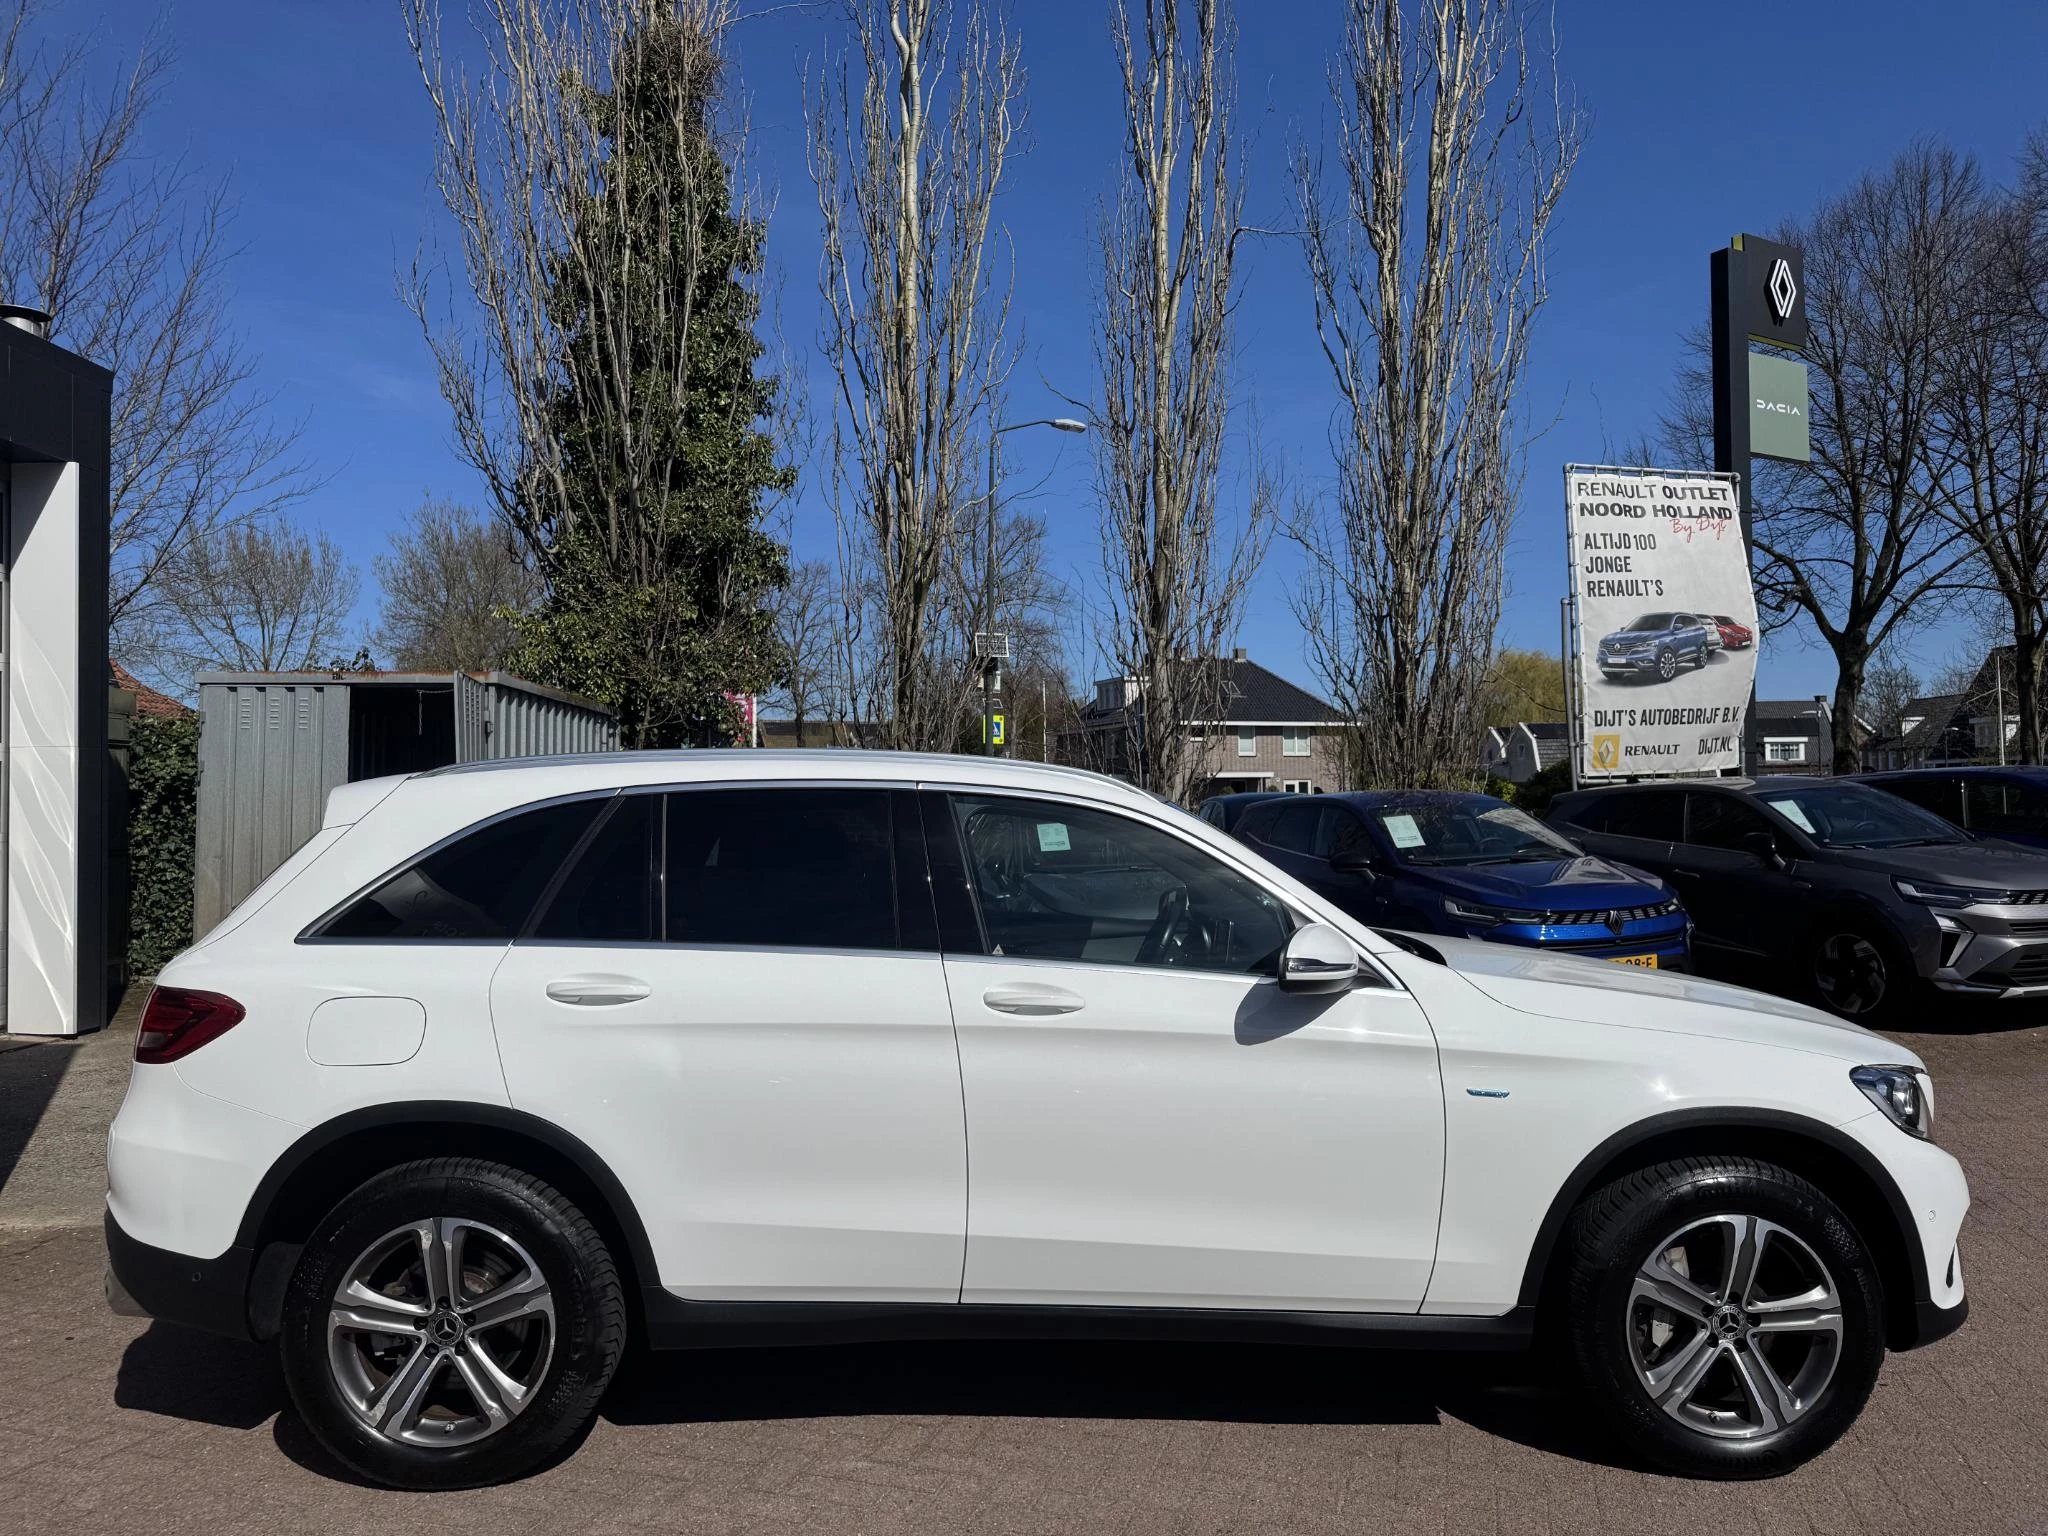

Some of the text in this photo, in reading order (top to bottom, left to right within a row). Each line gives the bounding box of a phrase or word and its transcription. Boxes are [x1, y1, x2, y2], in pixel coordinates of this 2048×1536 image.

[1756, 399, 1801, 416] DACIA
[1577, 482, 1728, 501] RENAULT OUTLET
[1579, 502, 1733, 520] NOORD HOLLAND
[1669, 518, 1696, 543] By
[1584, 532, 1657, 551] ALTIJD 100
[1585, 555, 1633, 574] JONGE
[1586, 579, 1664, 598] RENAULT'S
[1594, 706, 1740, 727] DIJT'S AUTOBEDRIJF B.V.
[1624, 744, 1681, 757] RENAULT
[1697, 735, 1733, 755] DIJT.NL
